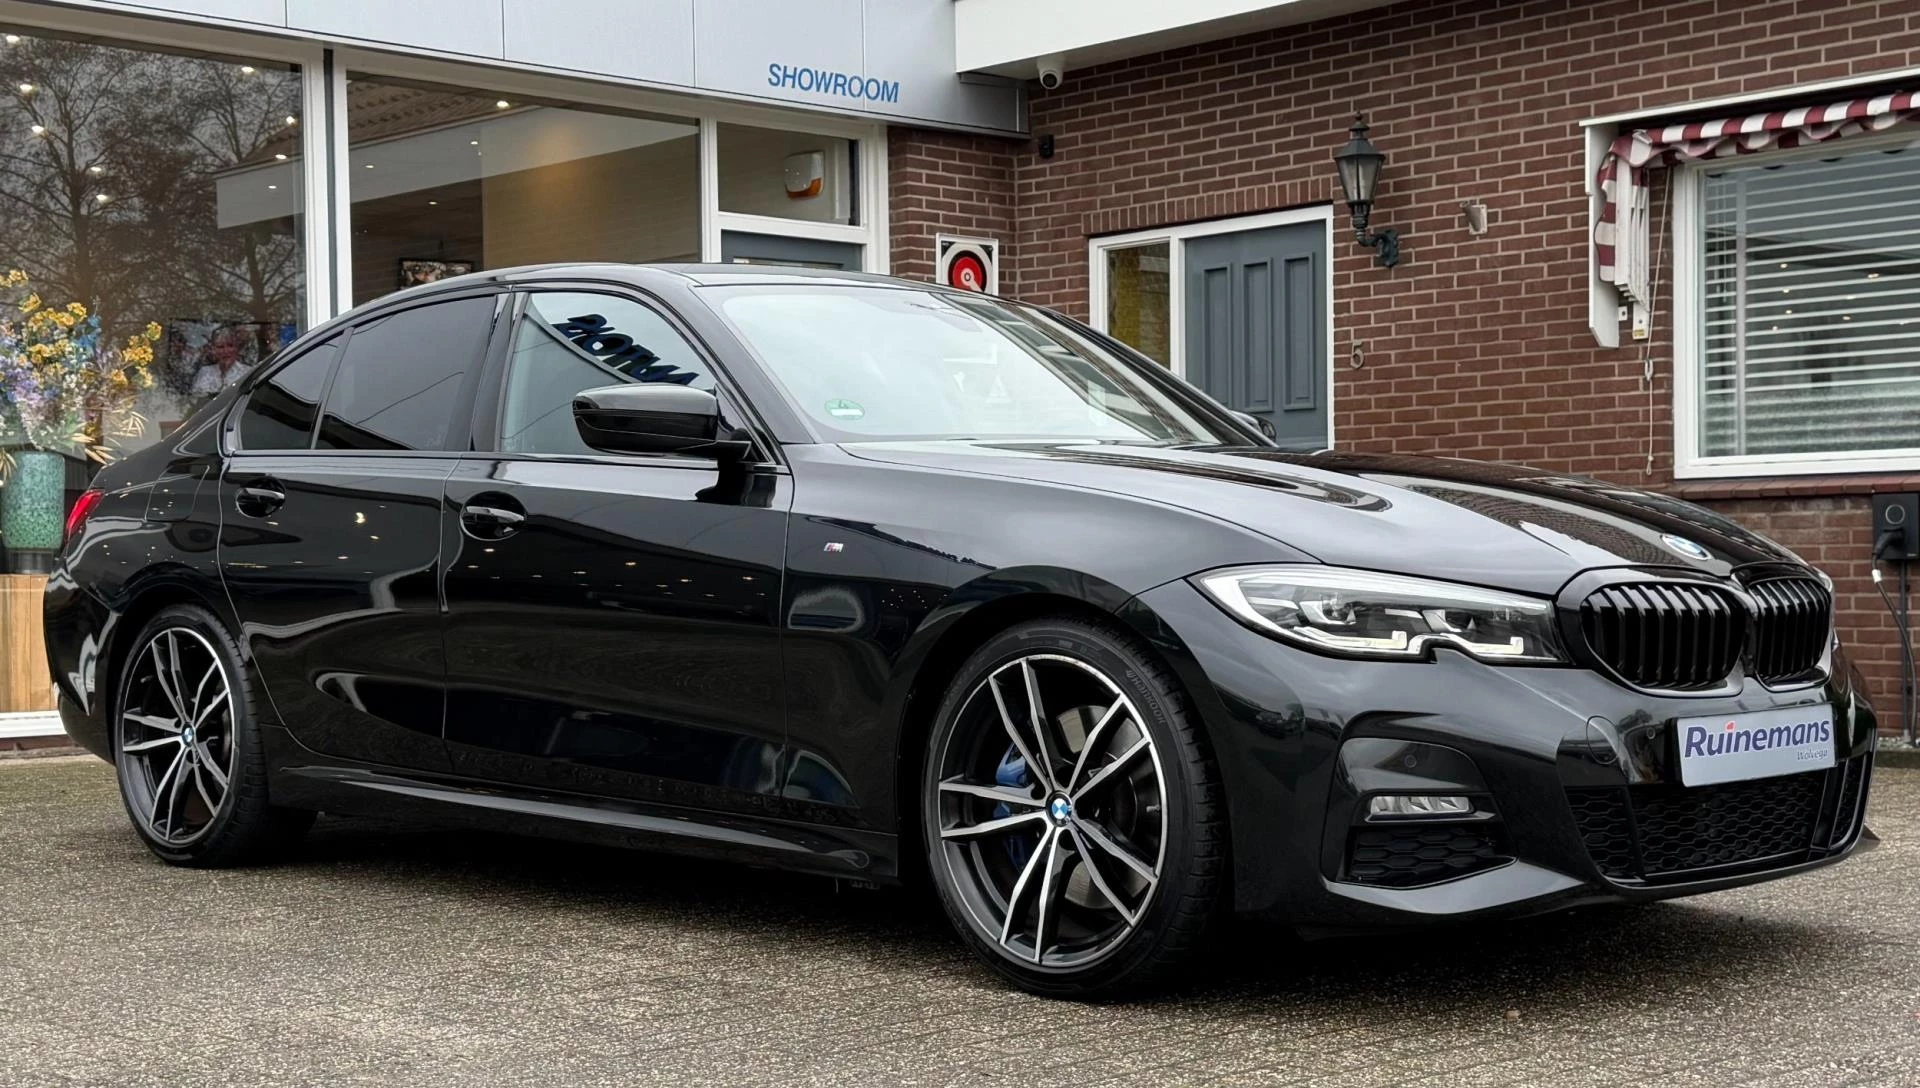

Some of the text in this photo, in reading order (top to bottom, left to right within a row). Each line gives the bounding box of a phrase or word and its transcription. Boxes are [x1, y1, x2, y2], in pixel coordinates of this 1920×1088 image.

[768, 63, 899, 103] SHOWROOM
[1351, 340, 1364, 369] 5
[1685, 720, 1830, 758] Ruinemans
